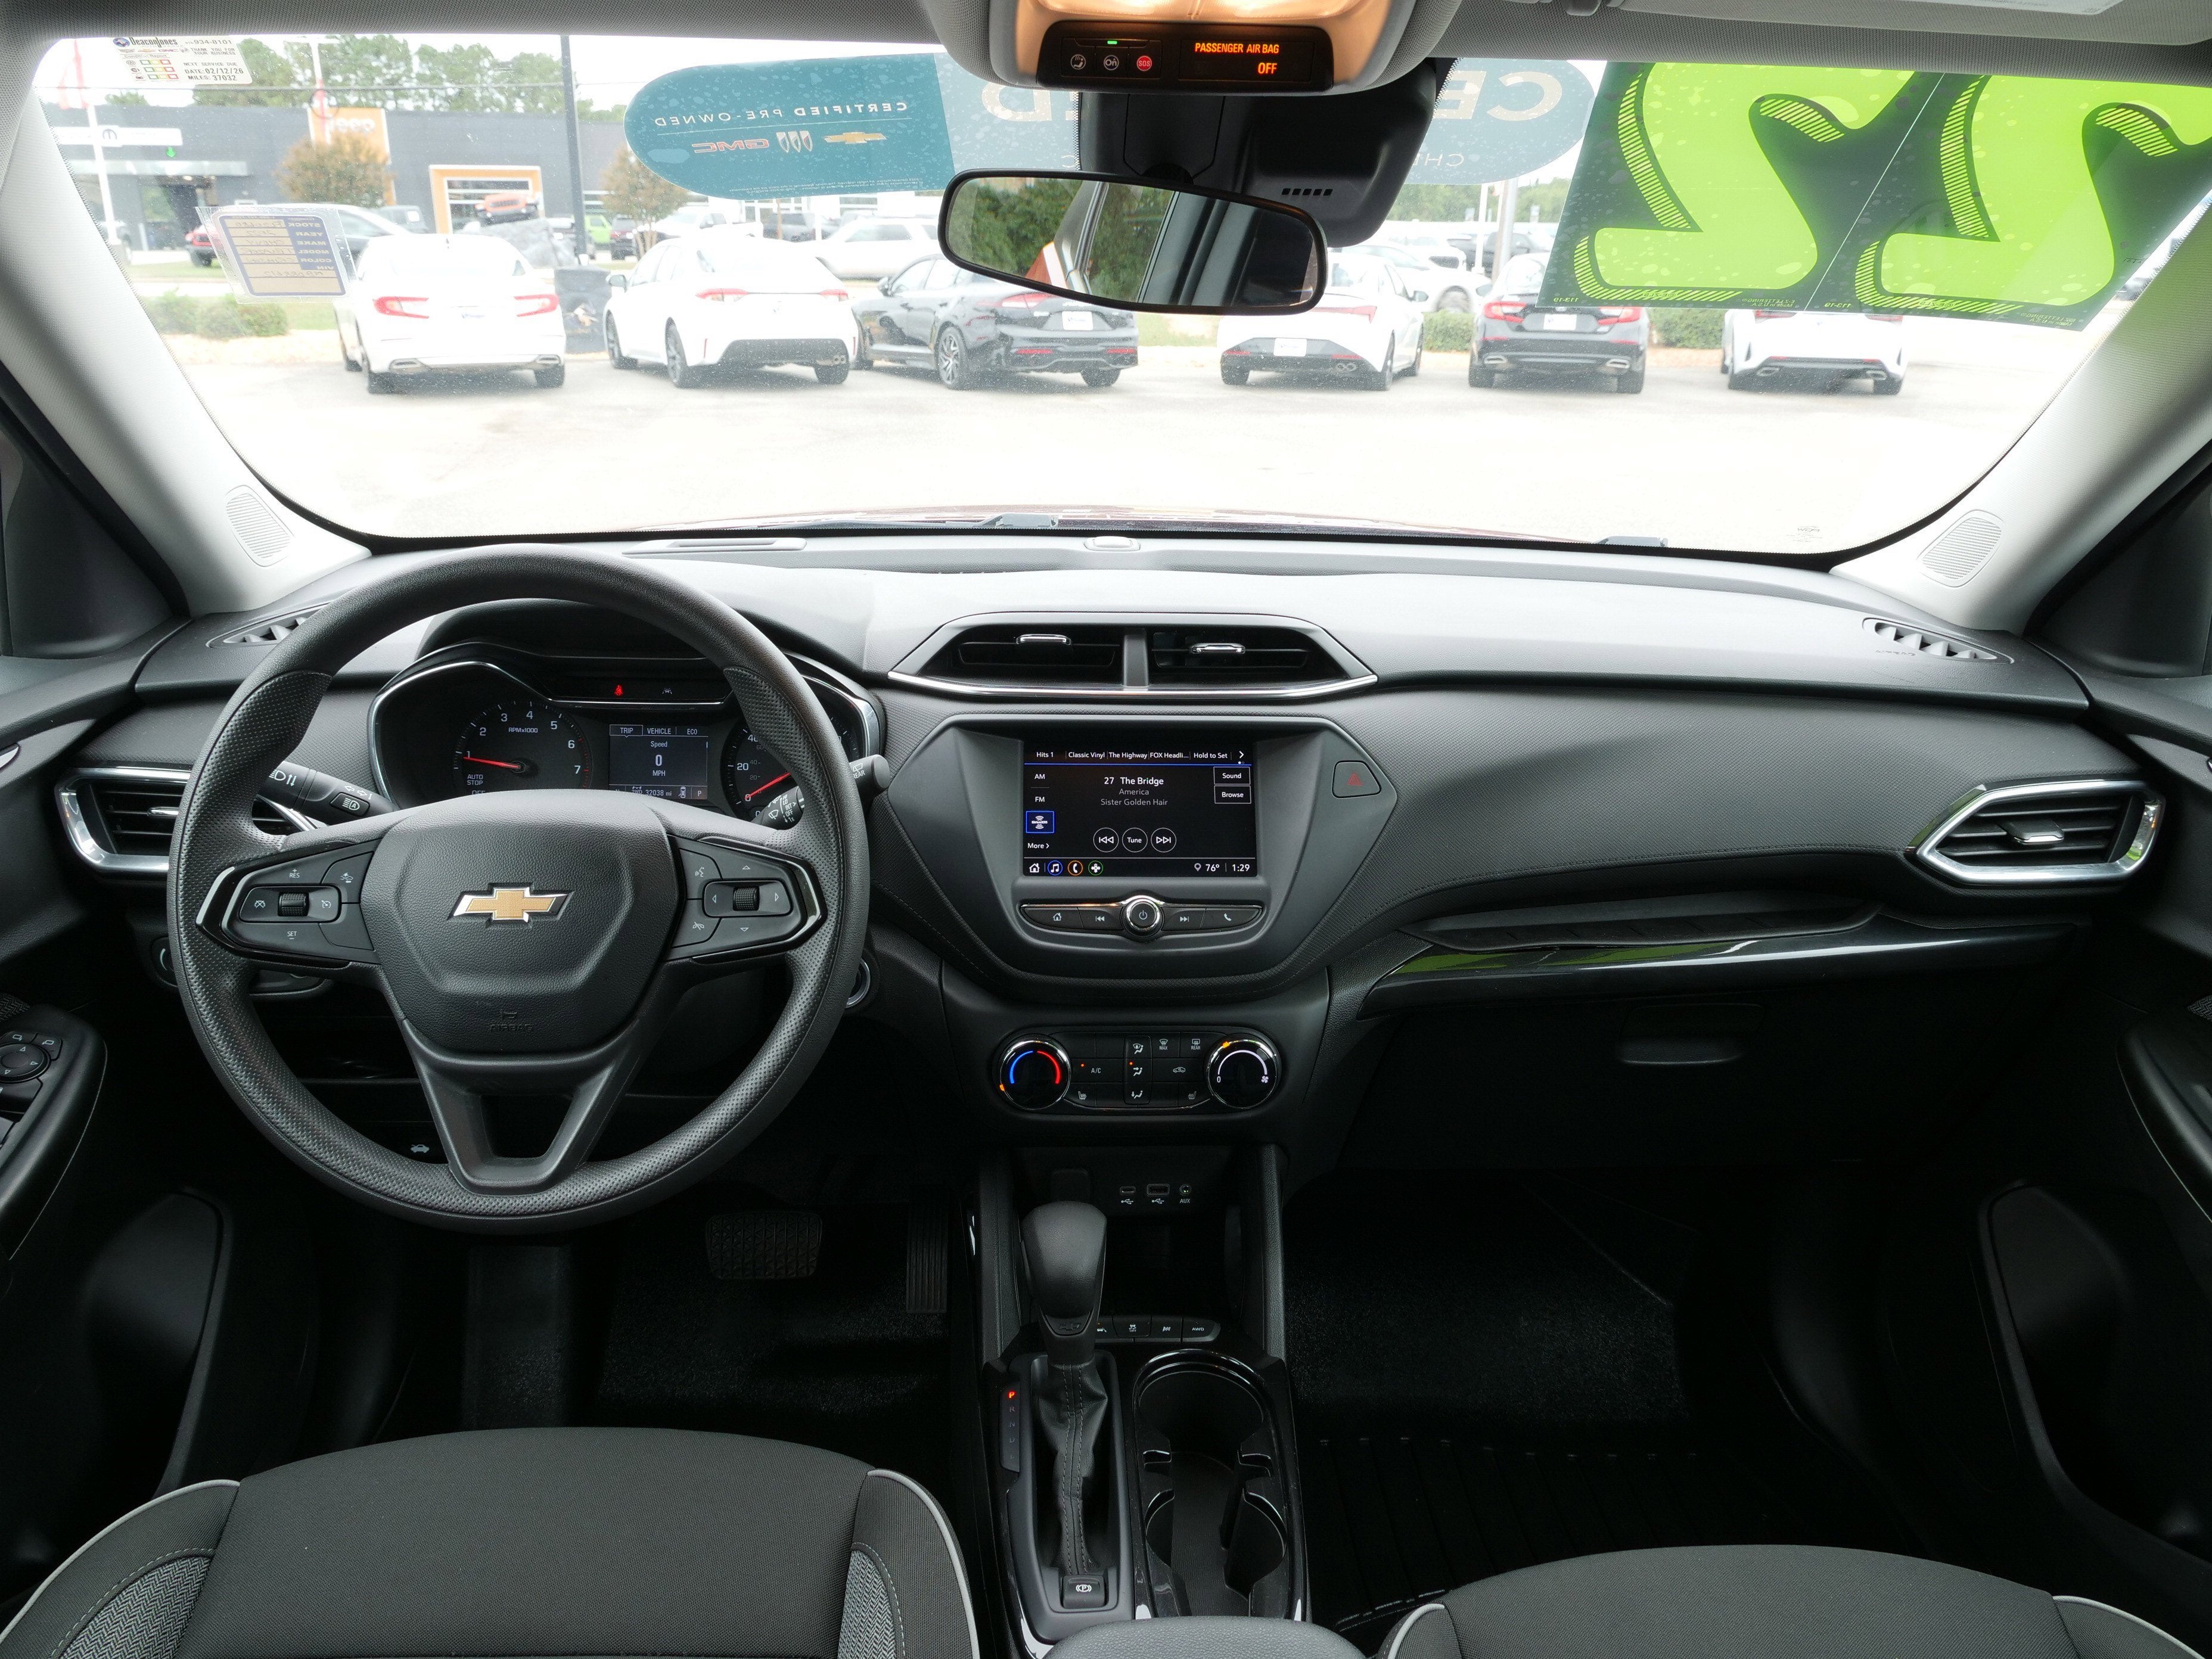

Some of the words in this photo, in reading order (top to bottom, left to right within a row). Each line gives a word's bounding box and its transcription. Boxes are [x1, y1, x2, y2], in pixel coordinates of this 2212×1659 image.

[1195, 42, 1243, 53] PASSENGER
[1247, 44, 1260, 54] AIR
[1262, 44, 1279, 54] BAG
[1257, 62, 1277, 74] OFF
[501, 713, 508, 722] 3
[526, 710, 533, 719] 4
[551, 721, 557, 729] 5
[479, 727, 486, 736] 2
[568, 740, 575, 748] 6
[655, 754, 663, 766] 0
[1122, 752, 1148, 760] Highway
[574, 765, 581, 774] 7
[1137, 777, 1164, 787] Bridge
[1232, 863, 1250, 872] 1:29
